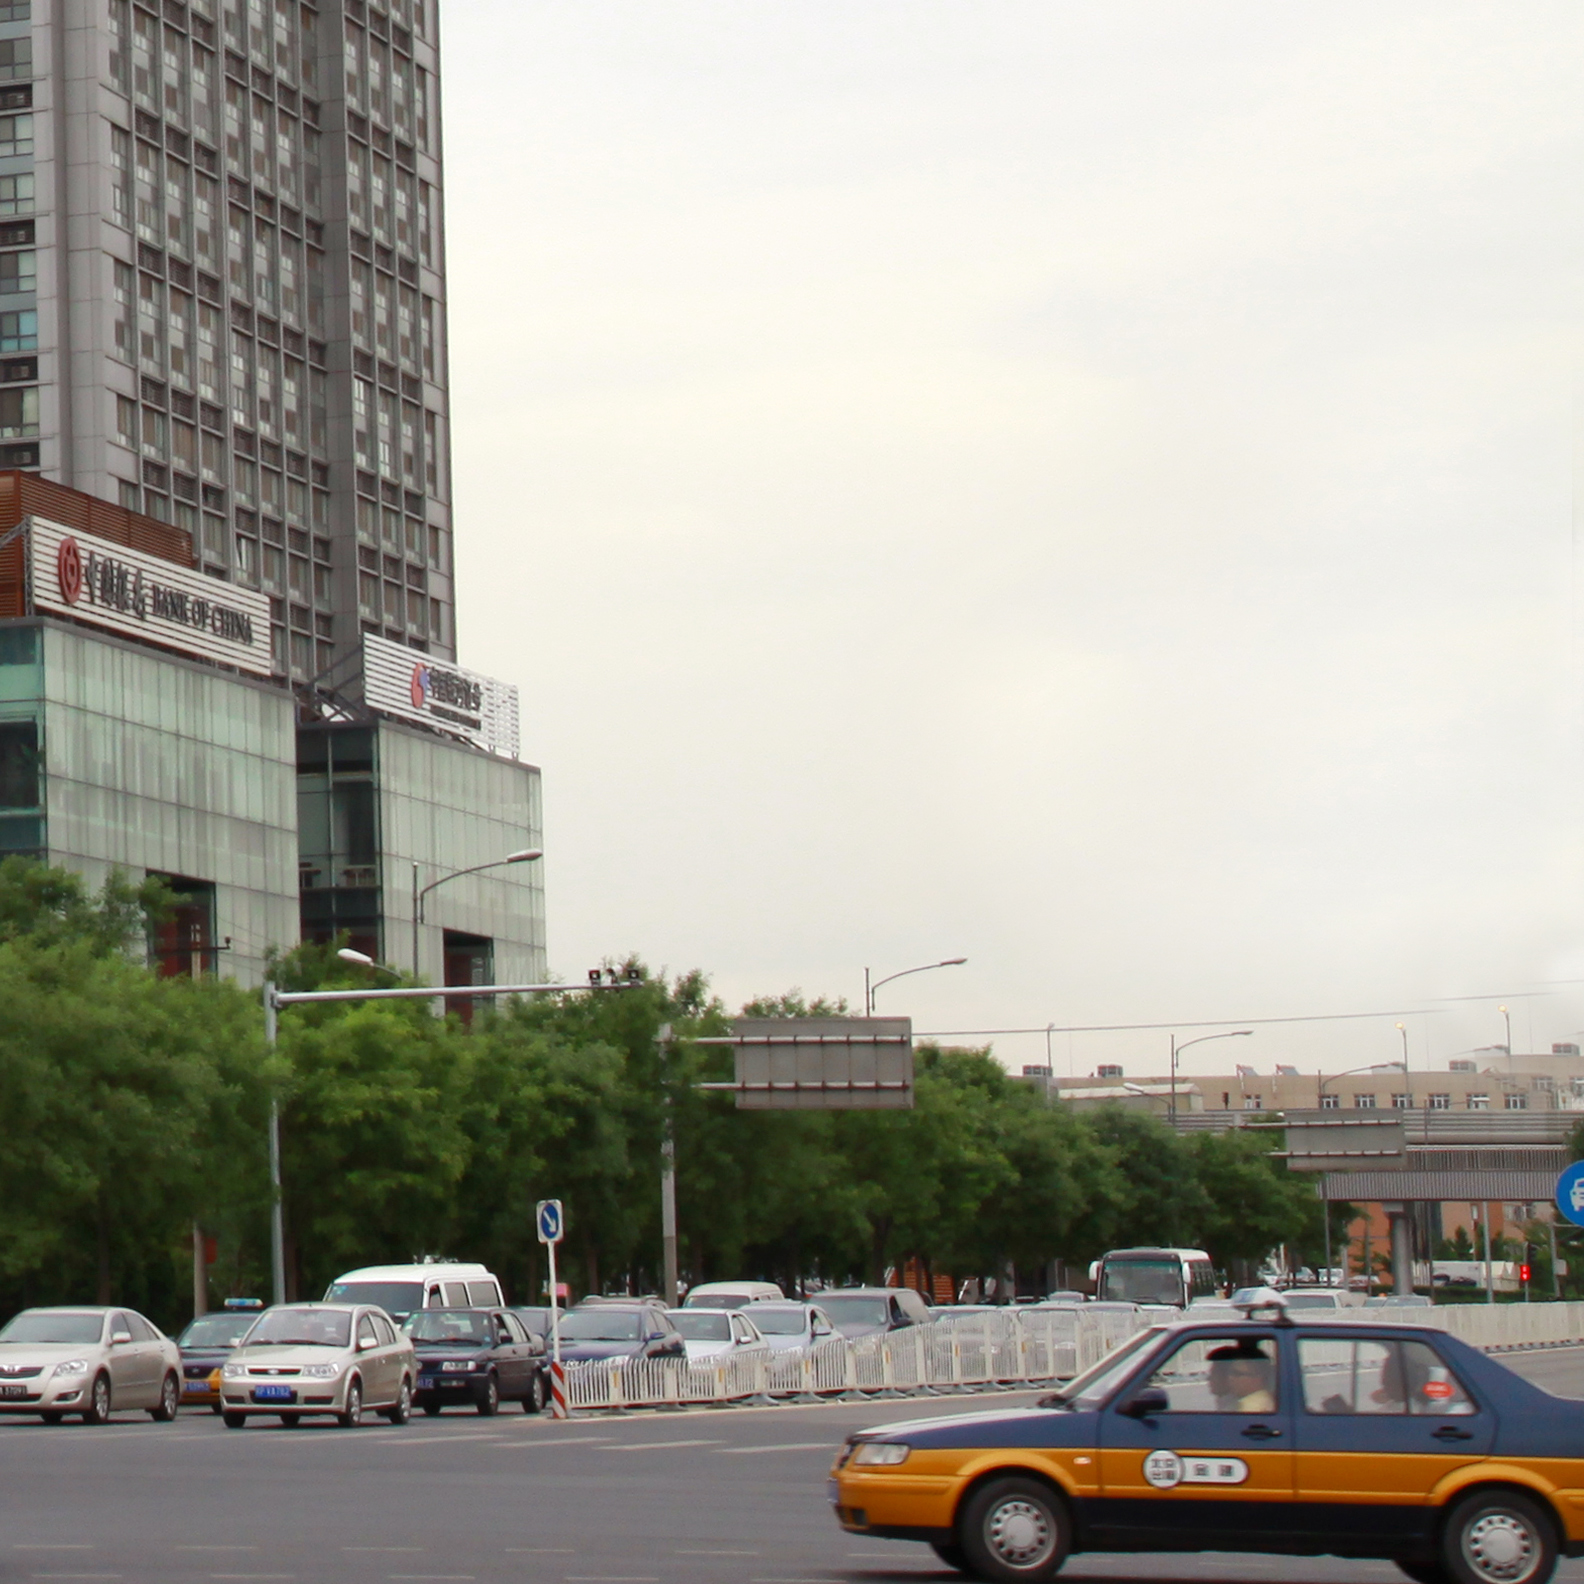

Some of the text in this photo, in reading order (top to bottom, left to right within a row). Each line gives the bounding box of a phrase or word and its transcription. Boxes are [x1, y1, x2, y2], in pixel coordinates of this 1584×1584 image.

[152, 584, 253, 645] BANK OF CHINA
